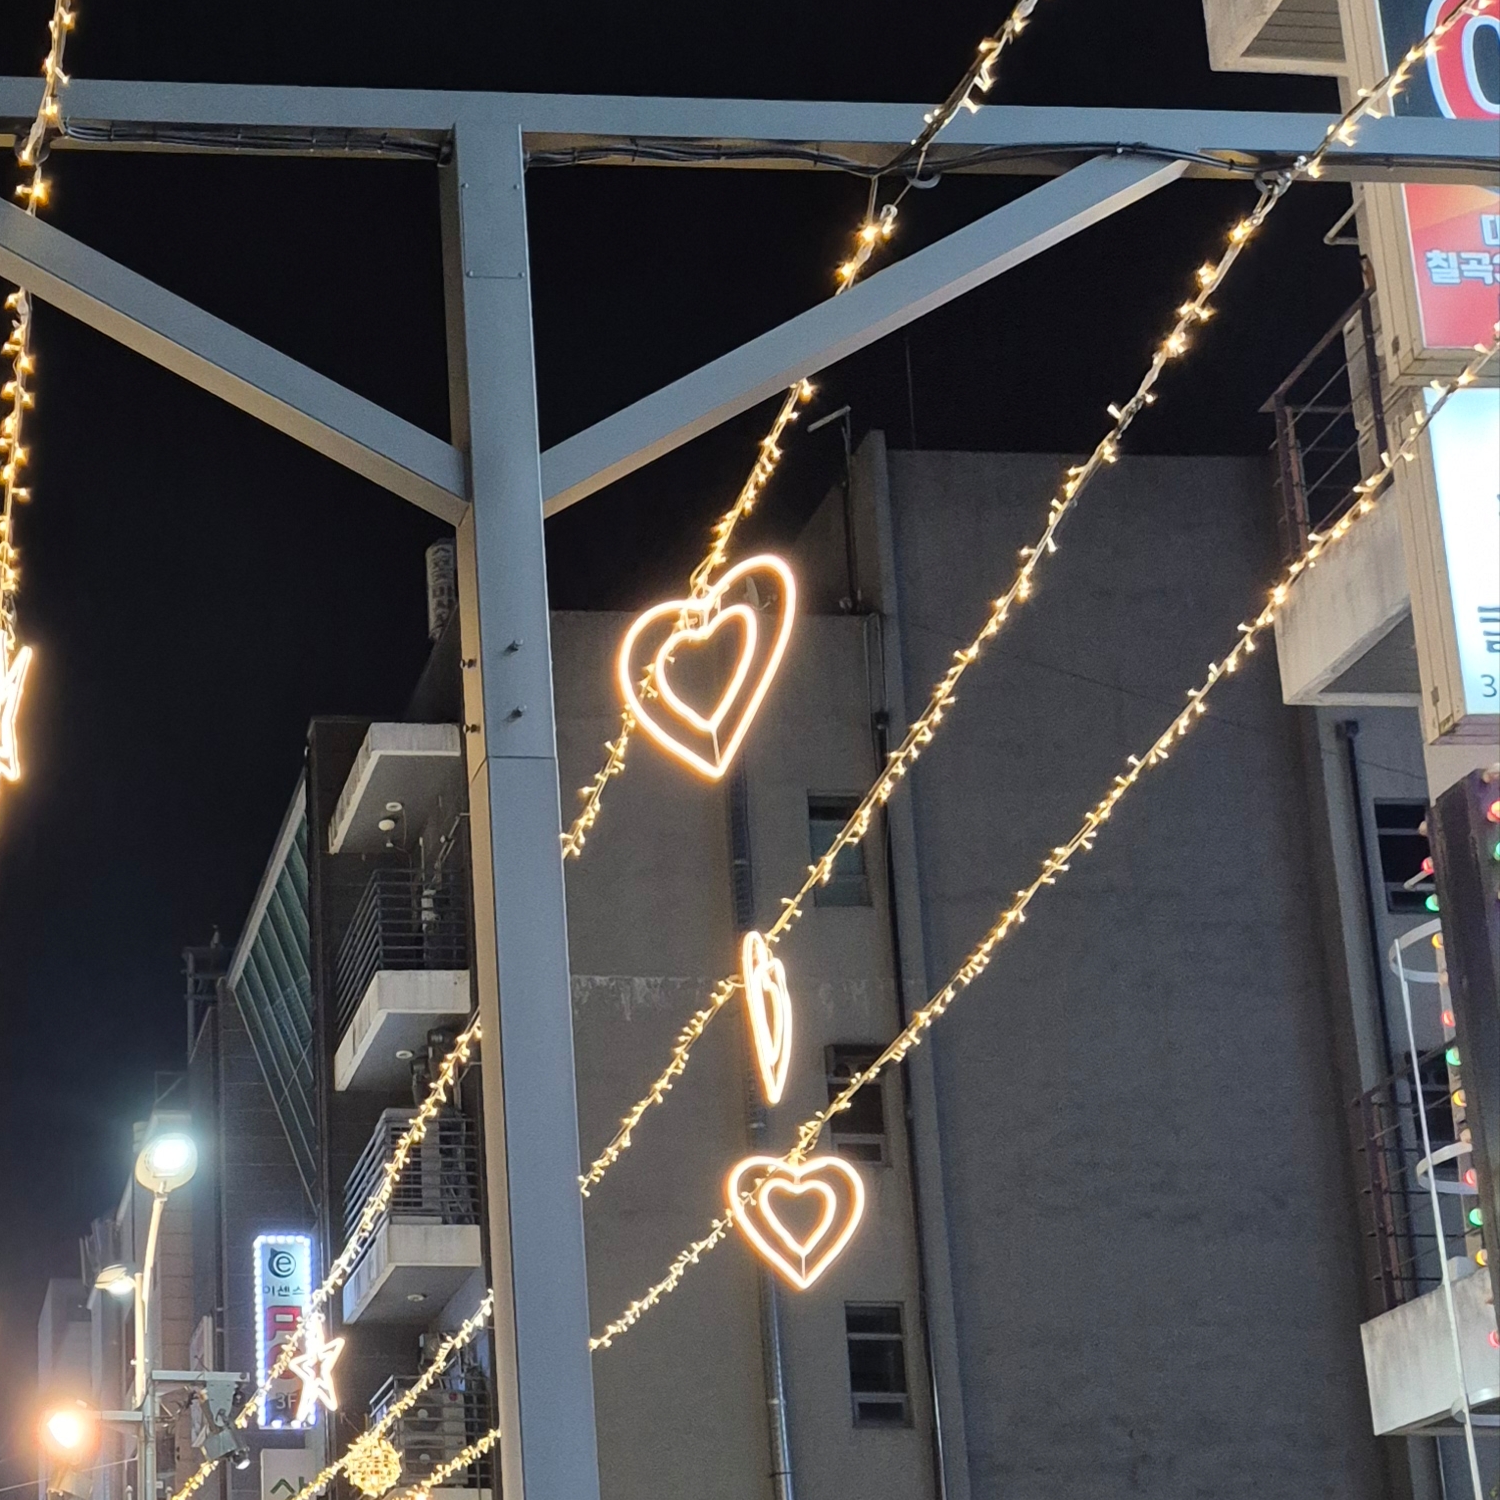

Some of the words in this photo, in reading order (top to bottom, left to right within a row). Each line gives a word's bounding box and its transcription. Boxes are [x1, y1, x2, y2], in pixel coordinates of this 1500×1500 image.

[1426, 249, 1500, 285] 칠곡
[263, 1284, 305, 1297] 이센스
[276, 1393, 297, 1410] 3F
